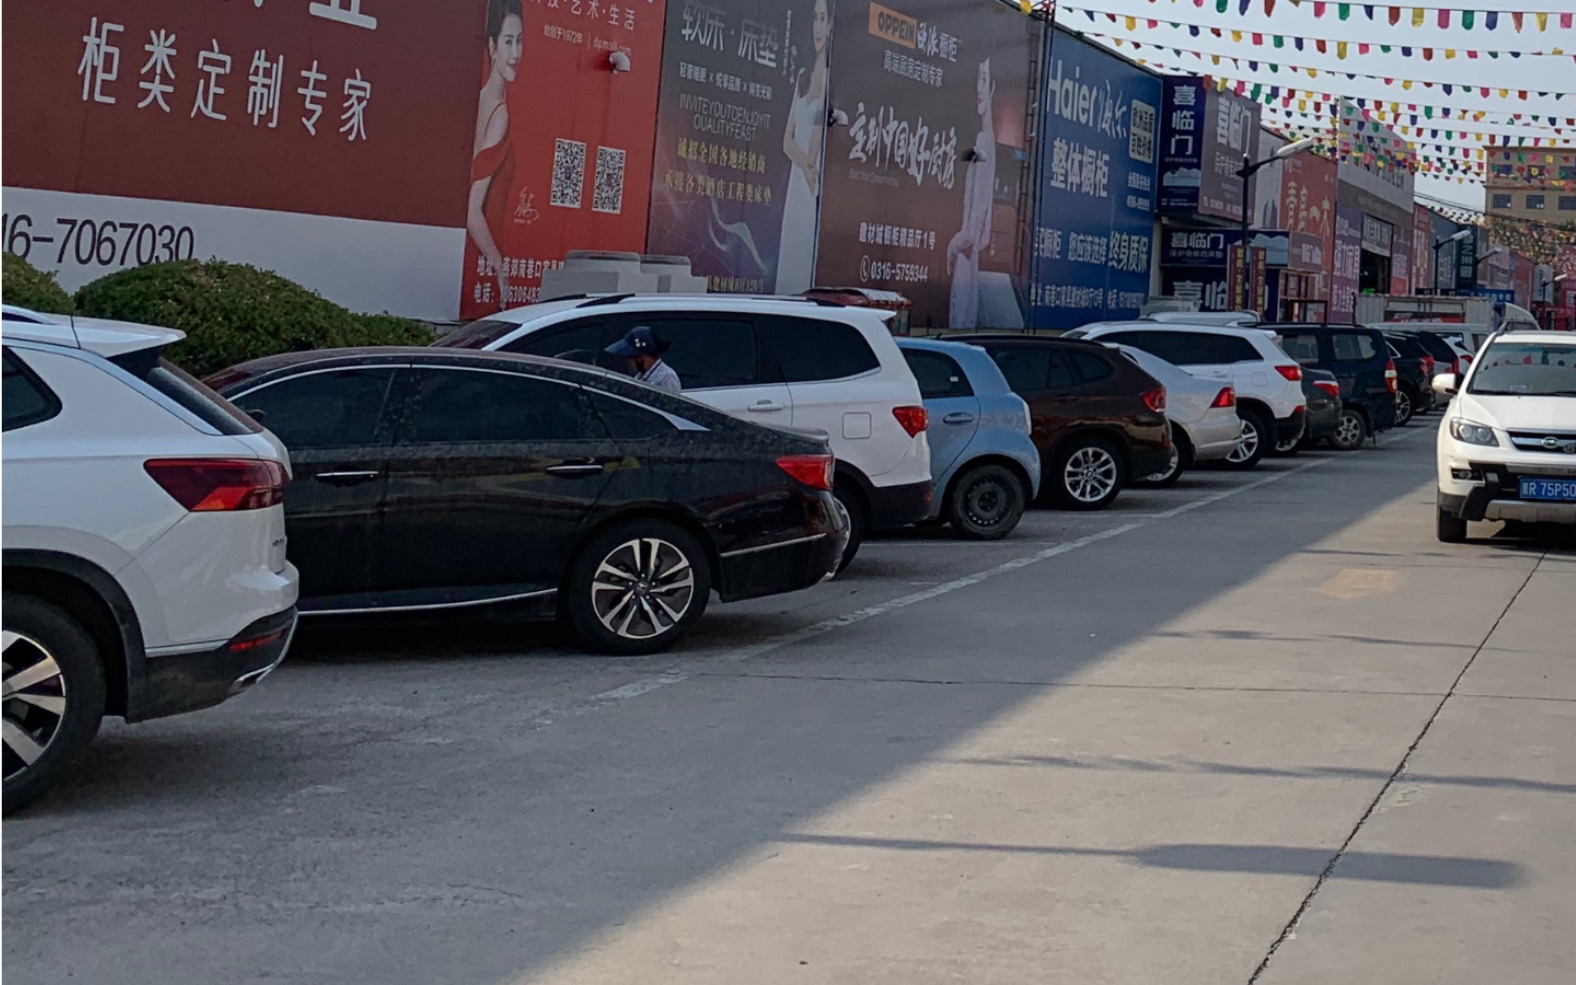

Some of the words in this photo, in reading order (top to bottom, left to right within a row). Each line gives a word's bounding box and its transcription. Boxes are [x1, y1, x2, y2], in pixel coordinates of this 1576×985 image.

[877, 11, 916, 44] OPPEIN
[77, 17, 372, 142] 柜类定制专家
[1046, 56, 1098, 128] Haier
[1172, 85, 1197, 155] 喜临门
[1170, 232, 1225, 249] 喜临门
